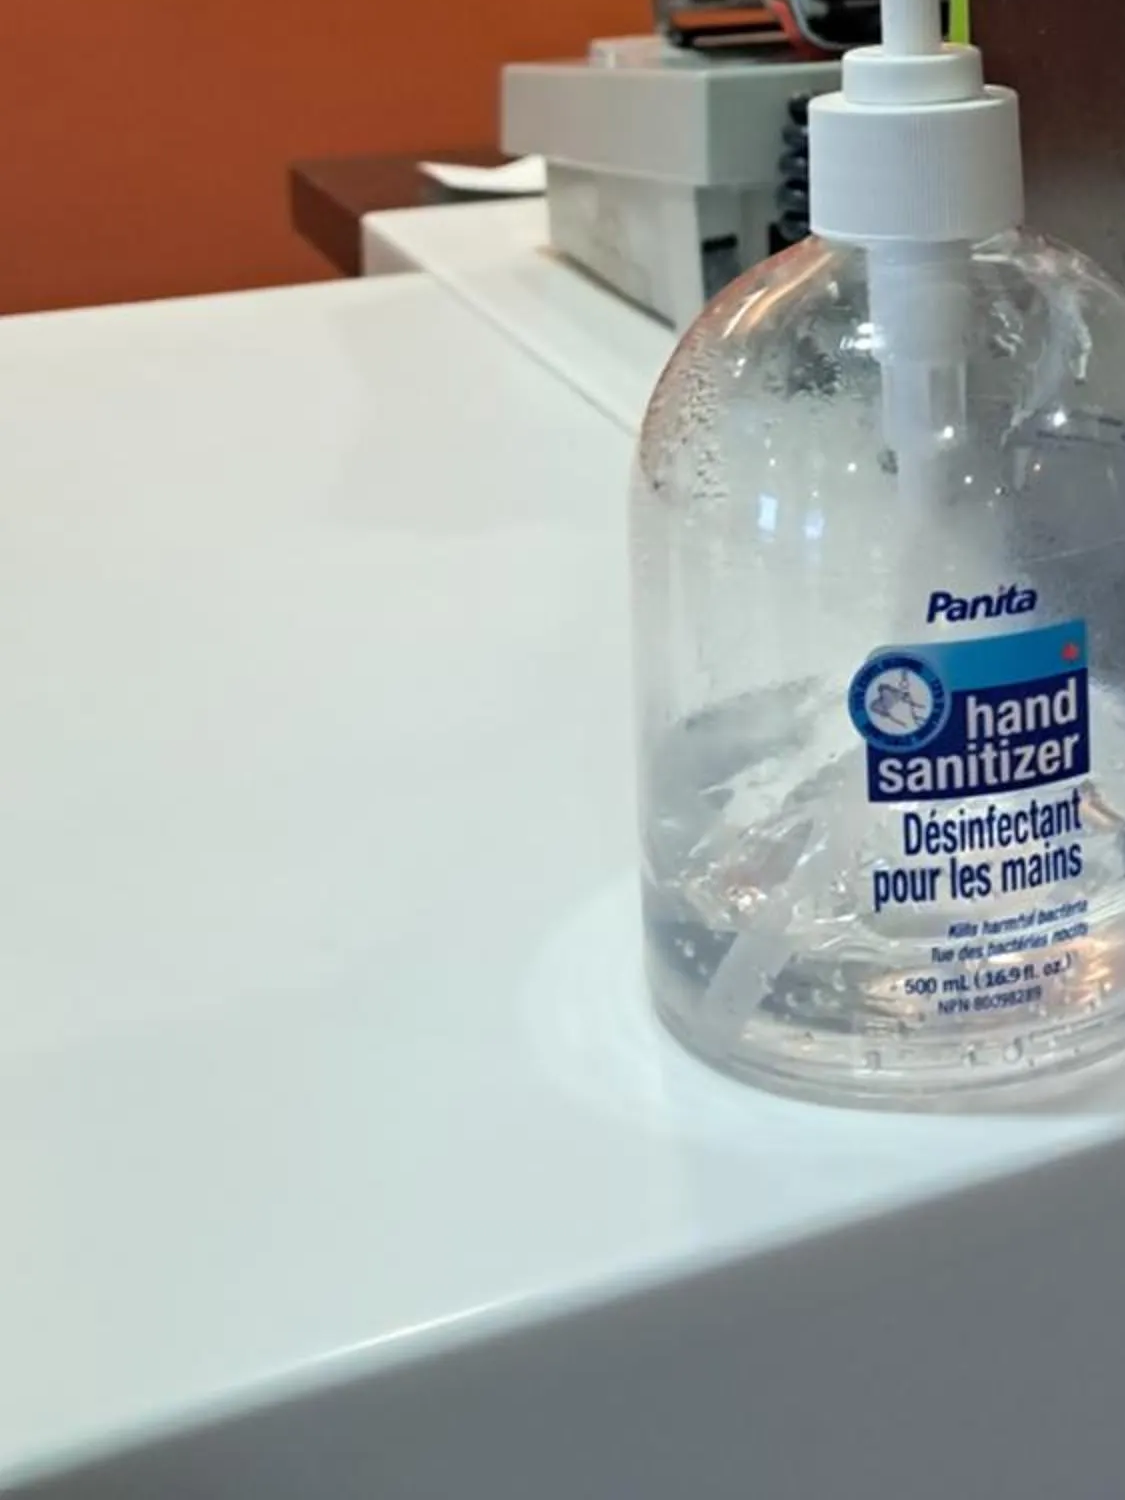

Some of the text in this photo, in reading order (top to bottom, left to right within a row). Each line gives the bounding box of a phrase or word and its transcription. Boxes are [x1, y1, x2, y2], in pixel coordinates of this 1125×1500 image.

[926, 583, 1037, 624] Panita
[967, 676, 1078, 741] hand
[877, 732, 1080, 794] sanitizer
[903, 787, 1082, 856] Désinfectant
[873, 841, 1083, 913] pour les mains
[958, 943, 983, 961] des
[904, 976, 937, 995] 500
[943, 974, 969, 993] mL
[938, 997, 970, 1015] NPN
